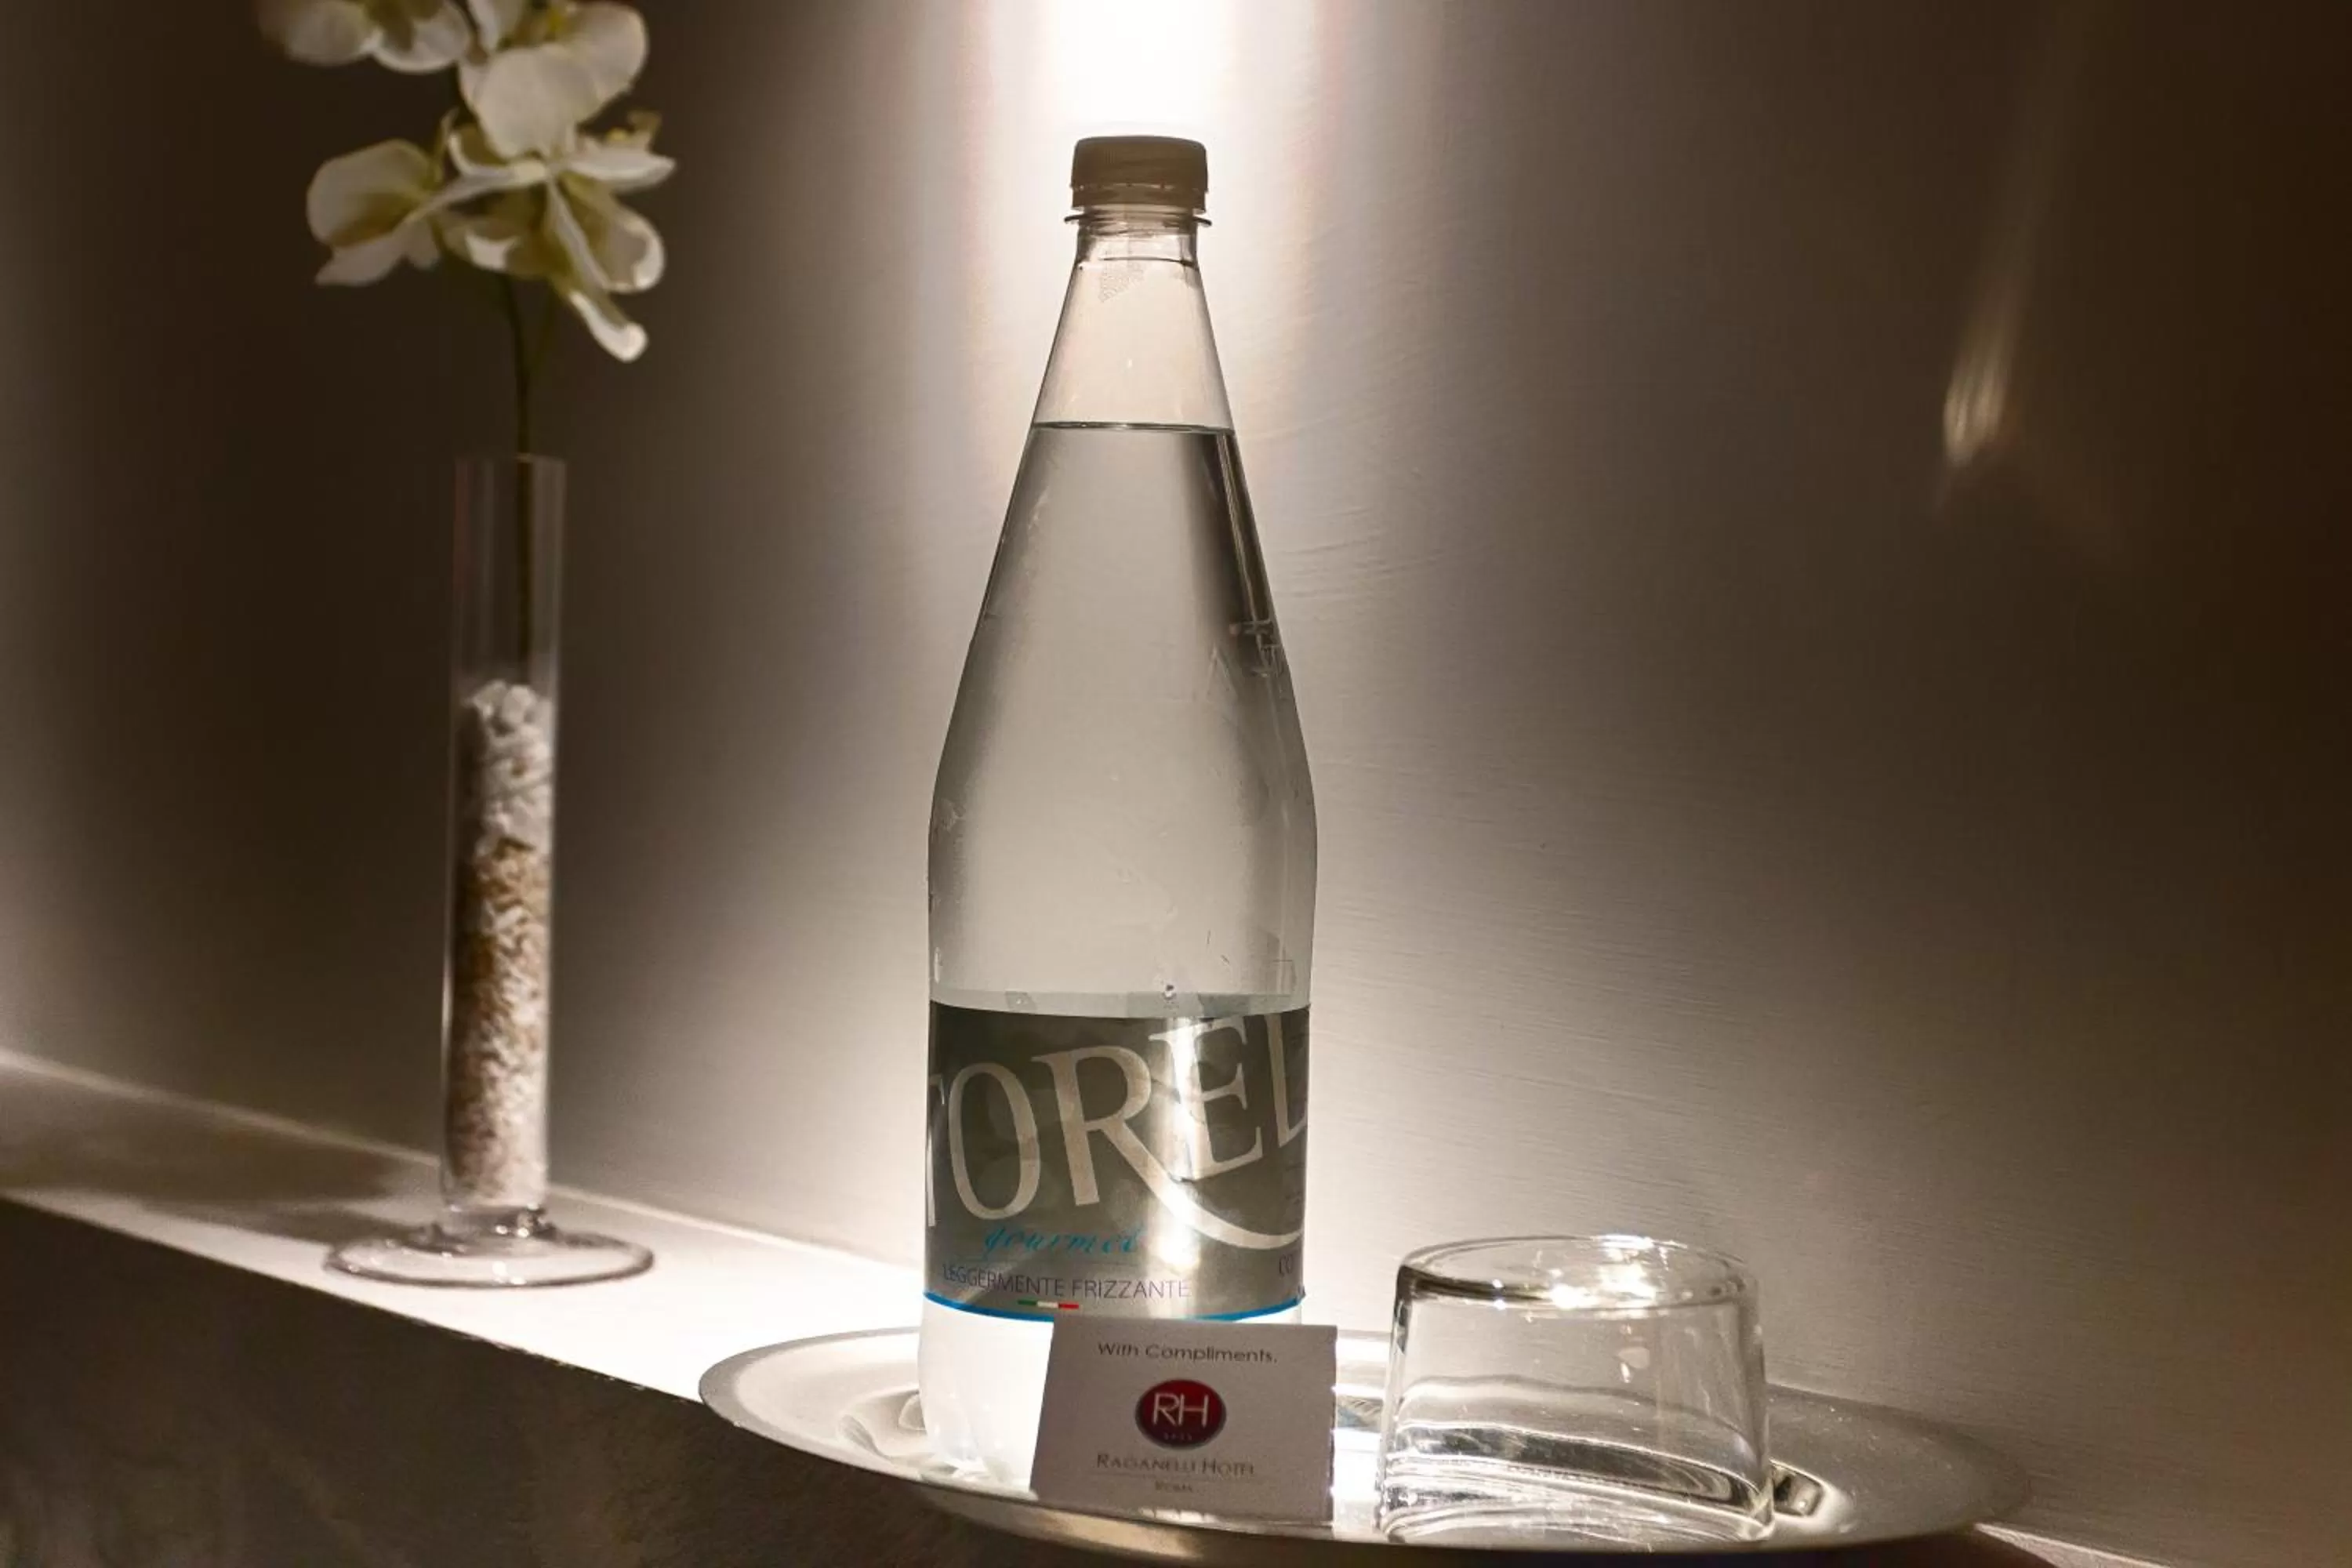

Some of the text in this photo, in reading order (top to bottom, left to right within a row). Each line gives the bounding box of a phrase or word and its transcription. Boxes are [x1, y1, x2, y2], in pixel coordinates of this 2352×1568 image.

[942, 1263, 1192, 1300] LEGGERMENTE FRIZZANTE
[1098, 1341, 1278, 1365] With Compliments.
[1152, 1392, 1210, 1428] RH
